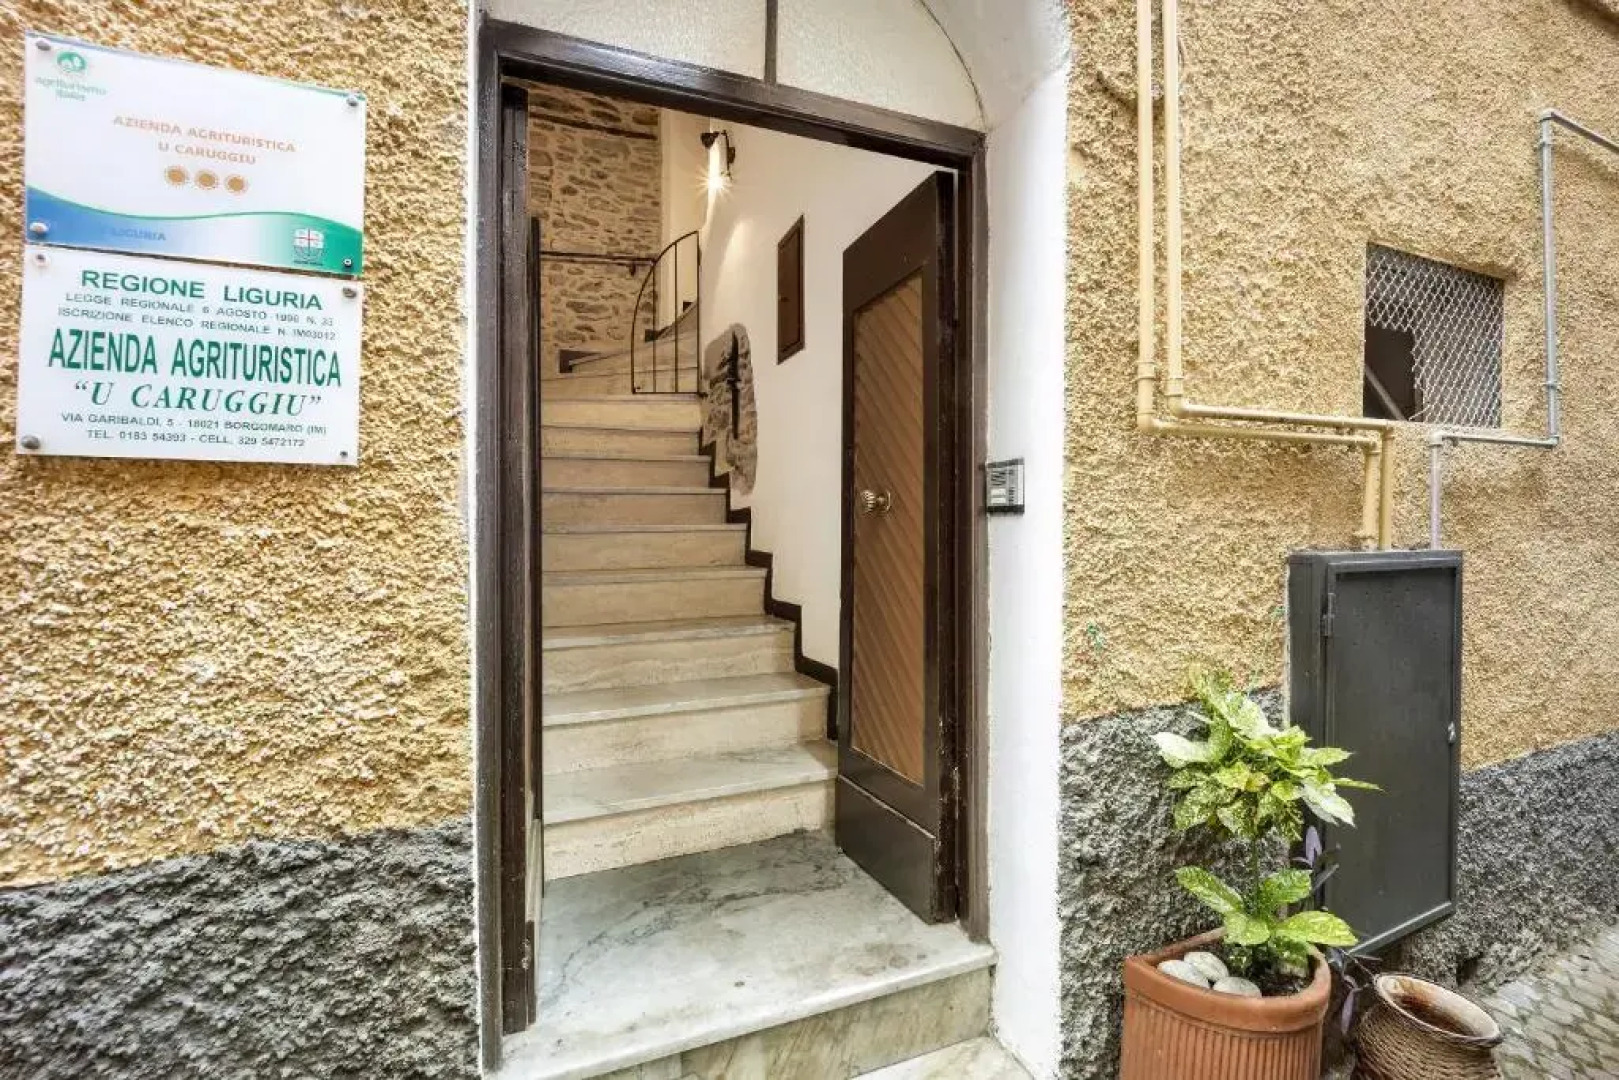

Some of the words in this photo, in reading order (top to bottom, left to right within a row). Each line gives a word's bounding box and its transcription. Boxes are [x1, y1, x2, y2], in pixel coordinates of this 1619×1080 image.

[113, 115, 182, 136] AZIENDA
[187, 127, 296, 152] AGRITURISTICA
[158, 141, 169, 152] U
[175, 144, 256, 165] CARUGGIU
[81, 269, 206, 299] REGIONE
[224, 284, 322, 311] LIGURIA
[58, 306, 133, 323] ISCRIZIONE
[141, 314, 194, 328] ELENCO
[201, 320, 271, 334] REGIONALE
[65, 293, 112, 306] LEGGE
[121, 296, 194, 313] REGIONALE
[216, 307, 267, 321] AGOSTO
[49, 328, 158, 374] AZIENDA
[171, 337, 341, 387] AGRITURISTICA
[61, 412, 83, 423] VIA
[166, 419, 174, 427] 5
[224, 421, 303, 433] BORGOMARO
[307, 424, 327, 435] (IM)
[119, 431, 147, 441] 0183
[152, 433, 185, 442] 54393
[238, 437, 257, 446] 329
[261, 437, 304, 447] 5472172
